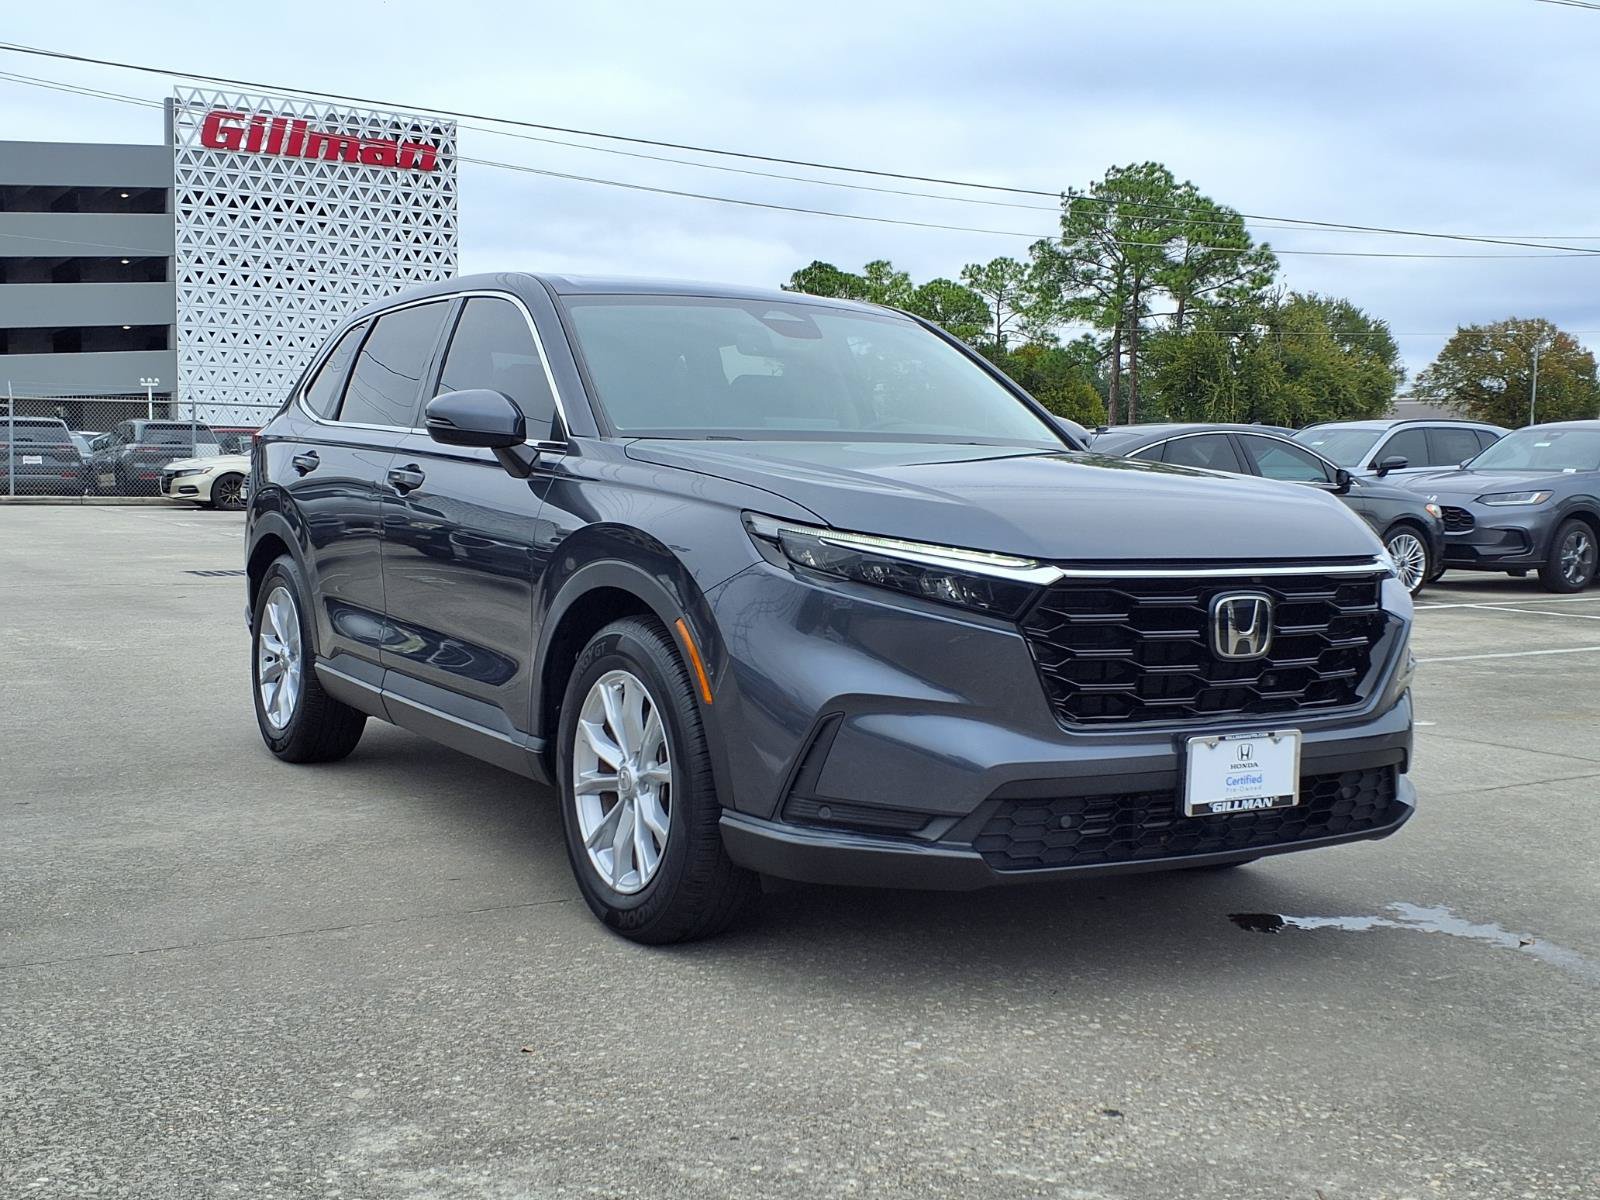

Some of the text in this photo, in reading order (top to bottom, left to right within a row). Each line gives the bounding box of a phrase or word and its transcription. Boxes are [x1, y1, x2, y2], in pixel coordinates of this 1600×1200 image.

[201, 110, 437, 171] Gillman
[1230, 761, 1259, 770] HONDA
[1226, 774, 1263, 787] Certified
[1226, 785, 1263, 793] Pre-Owned
[1212, 796, 1273, 813] GILLMAN
